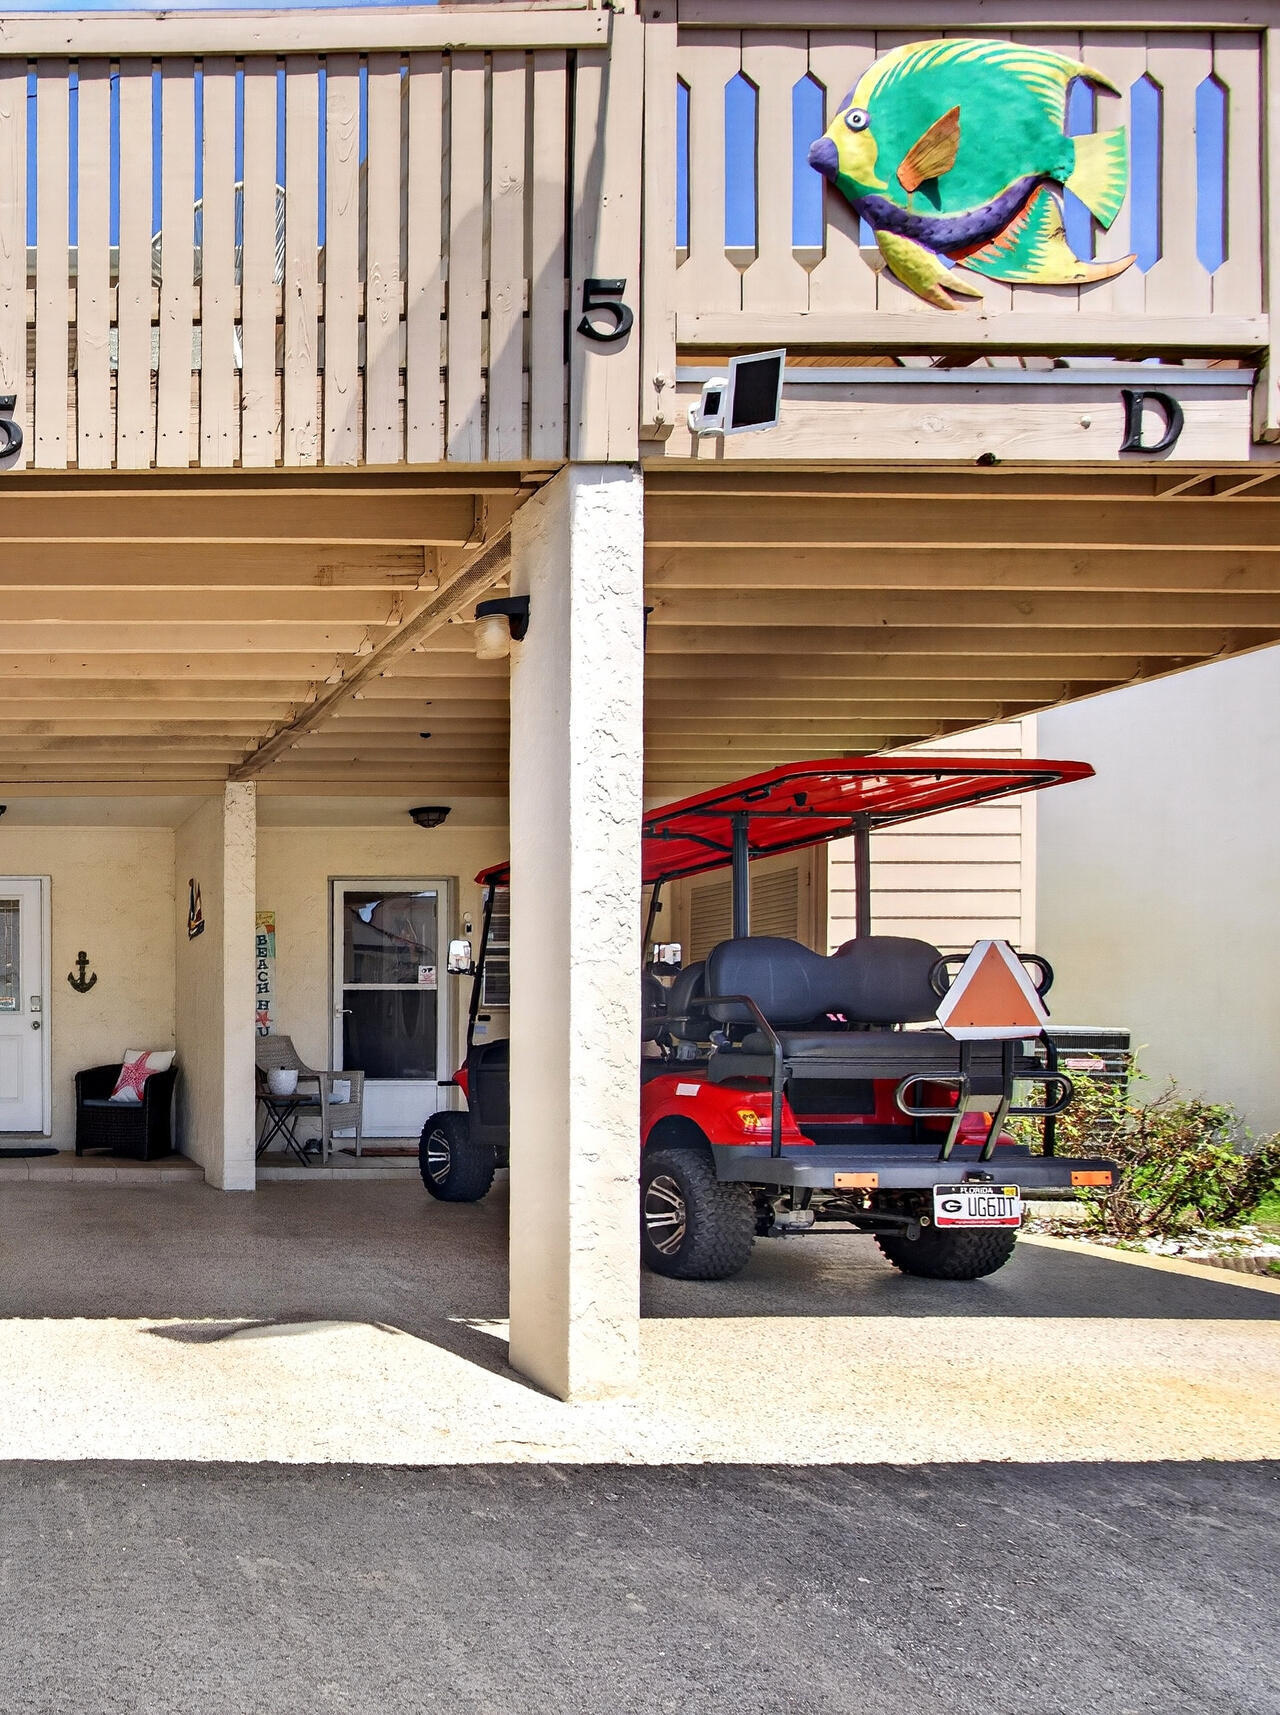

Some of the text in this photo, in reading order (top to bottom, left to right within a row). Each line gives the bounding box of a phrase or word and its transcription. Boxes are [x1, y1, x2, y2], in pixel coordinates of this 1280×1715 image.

[577, 278, 633, 342] 5
[1119, 389, 1185, 453] D
[256, 934, 270, 994] BEACH
